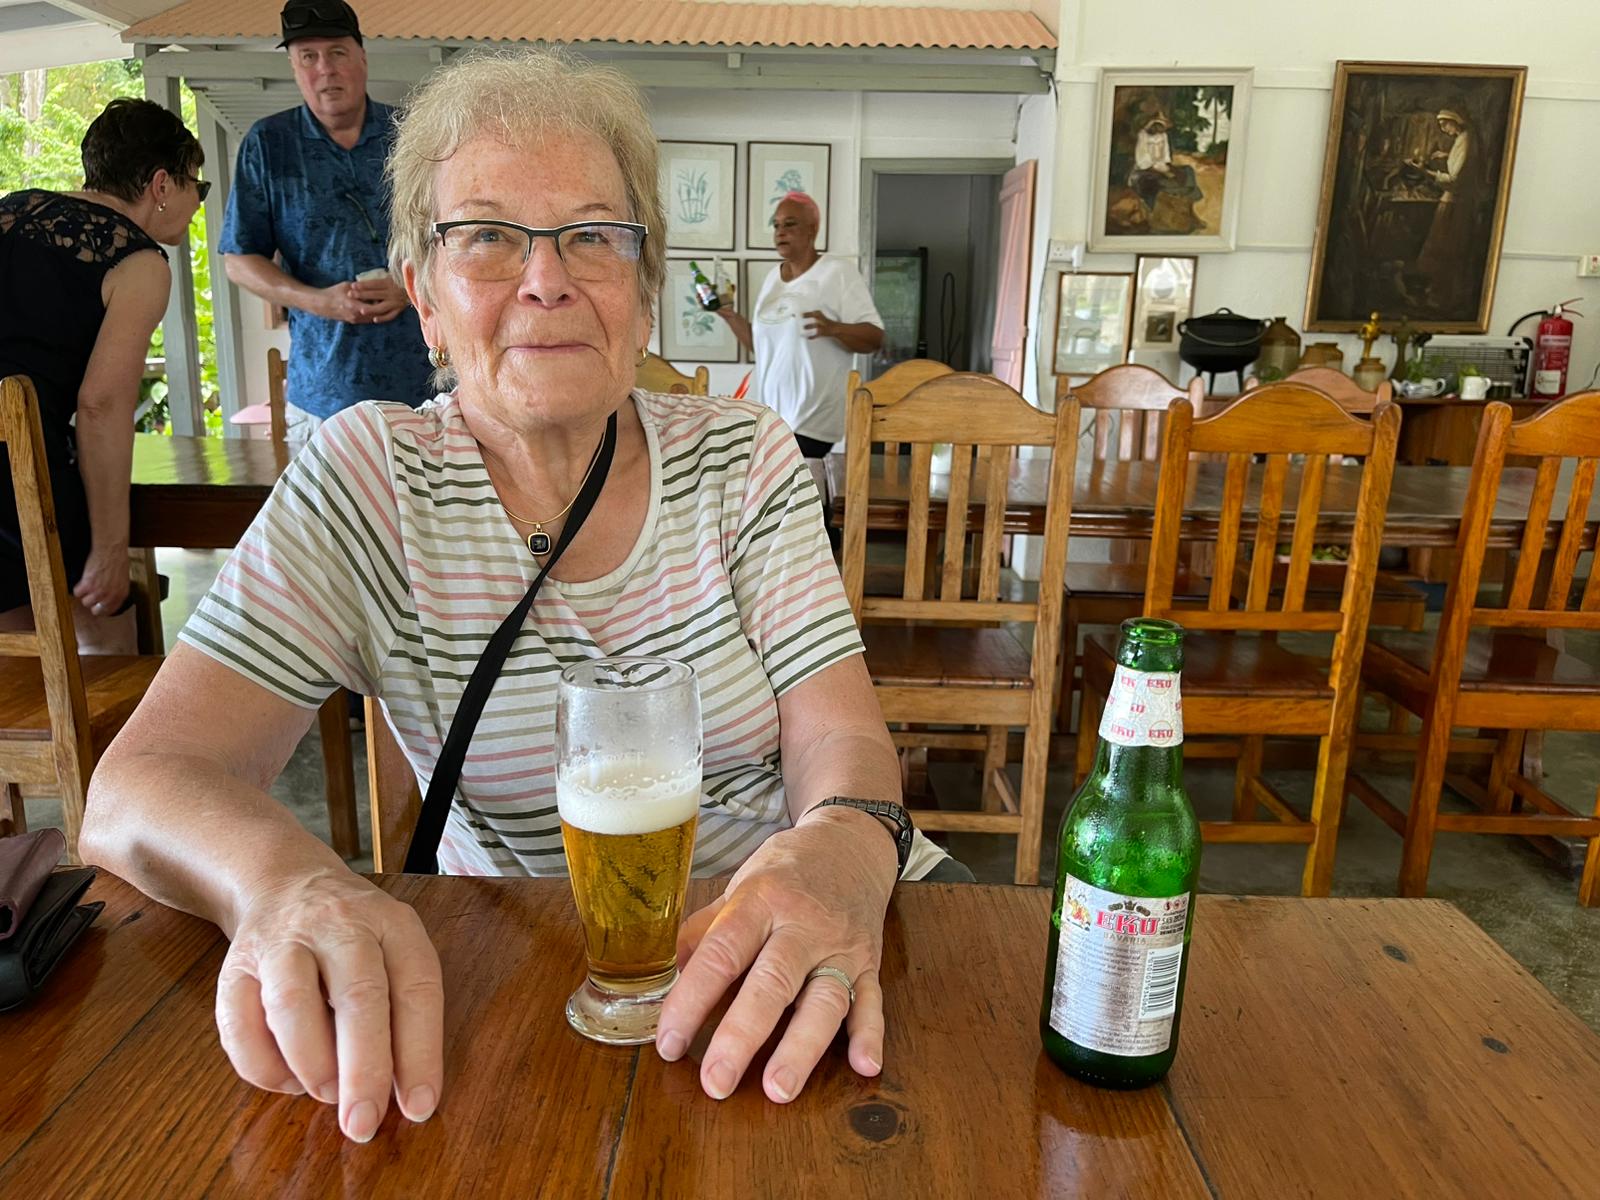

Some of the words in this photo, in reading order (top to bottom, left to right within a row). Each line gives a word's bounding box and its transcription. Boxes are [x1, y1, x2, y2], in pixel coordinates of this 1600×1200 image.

[1147, 679, 1172, 688] EKU
[1111, 725, 1135, 738] EKU
[1148, 729, 1174, 738] EKU
[1095, 910, 1160, 936] EKU
